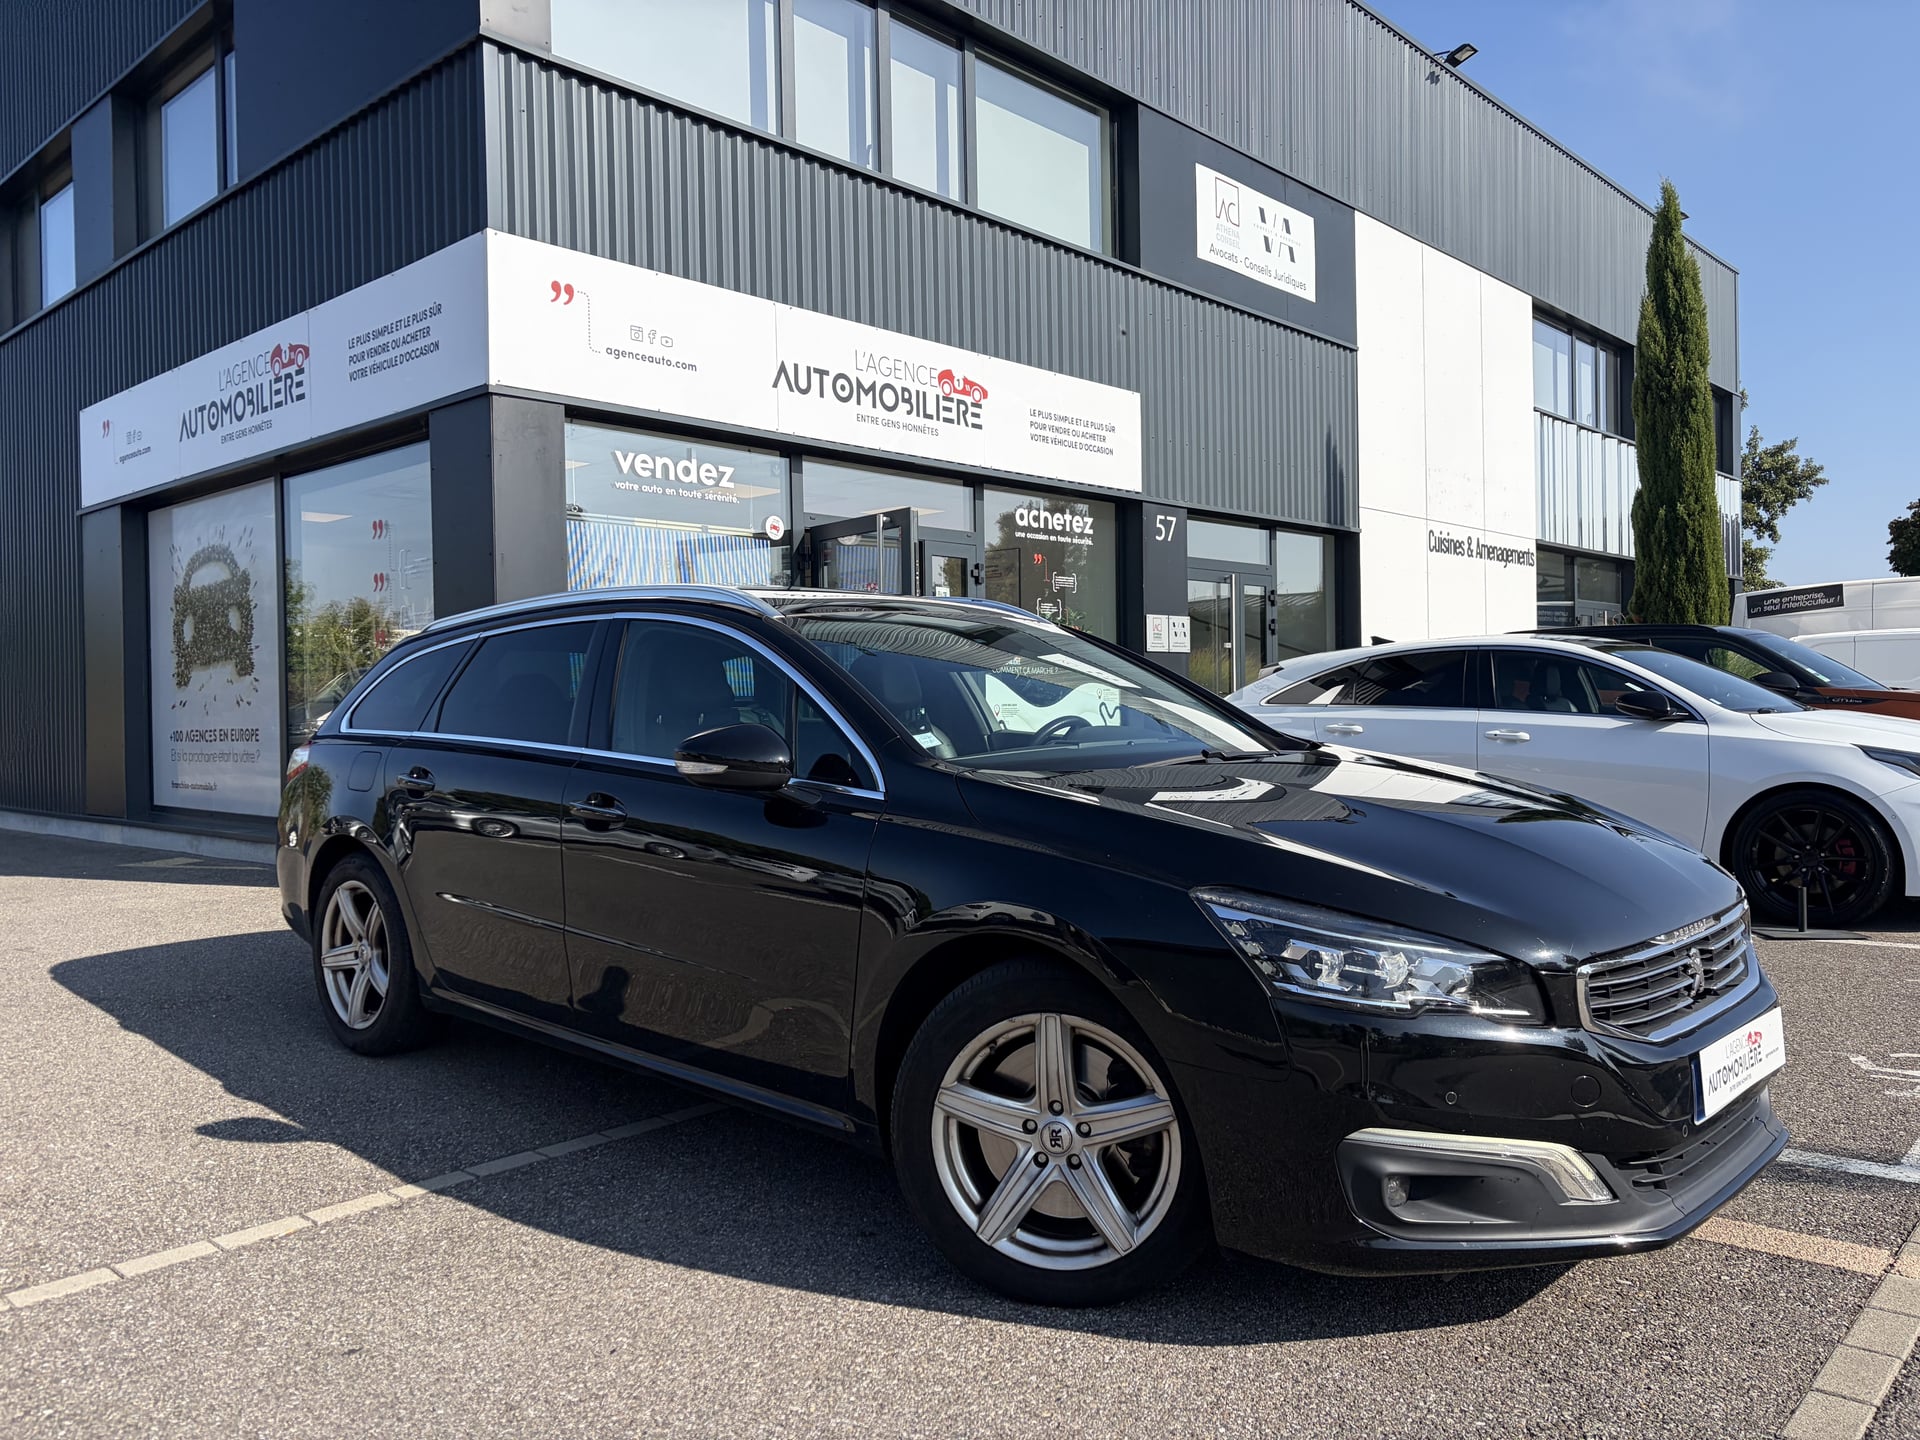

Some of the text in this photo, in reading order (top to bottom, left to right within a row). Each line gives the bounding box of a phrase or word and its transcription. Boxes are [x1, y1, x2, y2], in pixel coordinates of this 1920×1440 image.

[1209, 243, 1238, 264] Avocats
[1244, 257, 1272, 278] Conseils
[1273, 269, 1307, 291] Juridiques
[348, 337, 355, 350] LE
[356, 332, 371, 347] PLUS
[372, 322, 394, 340] SIMPLE
[395, 318, 403, 331] ET
[404, 315, 411, 329] LE
[411, 309, 428, 325] PLUS
[349, 325, 431, 366] POUR VENDRE OU ACHETER
[218, 350, 271, 392] L'AGENCE
[349, 340, 440, 382] VOTRE VÉHICULE D'OCCASION
[606, 347, 697, 372] agenceauto.com
[855, 349, 938, 388] L'AGENCE
[856, 413, 880, 425] ENTRE
[881, 418, 901, 430] GENS
[1029, 408, 1037, 417] LE
[1037, 410, 1052, 420] PLUS
[1053, 413, 1074, 425] SIMPLE
[1075, 418, 1082, 427] ET
[1083, 419, 1089, 428] LE
[1090, 421, 1104, 431] PLUS
[1029, 421, 1106, 443] POUR VENDRE OU ACHETER
[221, 432, 235, 444] ENTRE
[235, 428, 248, 440] GENS
[1030, 433, 1049, 444] VOTRE
[1079, 442, 1114, 456] D'OCCASION
[614, 448, 735, 489] vendez
[614, 481, 740, 504] votre auto en toute sérénité.
[1015, 503, 1094, 535] achetez
[1155, 515, 1176, 541] 57
[1026, 531, 1049, 541] occasion
[1057, 535, 1072, 543] toute
[1428, 529, 1535, 568] Cuisines & Amenagements
[1750, 606, 1762, 614] un
[1763, 603, 1781, 612] seul
[1781, 596, 1835, 609] interlocuteur
[1763, 597, 1780, 605] une
[169, 728, 260, 743] +100 AGENCES EN EUROPE
